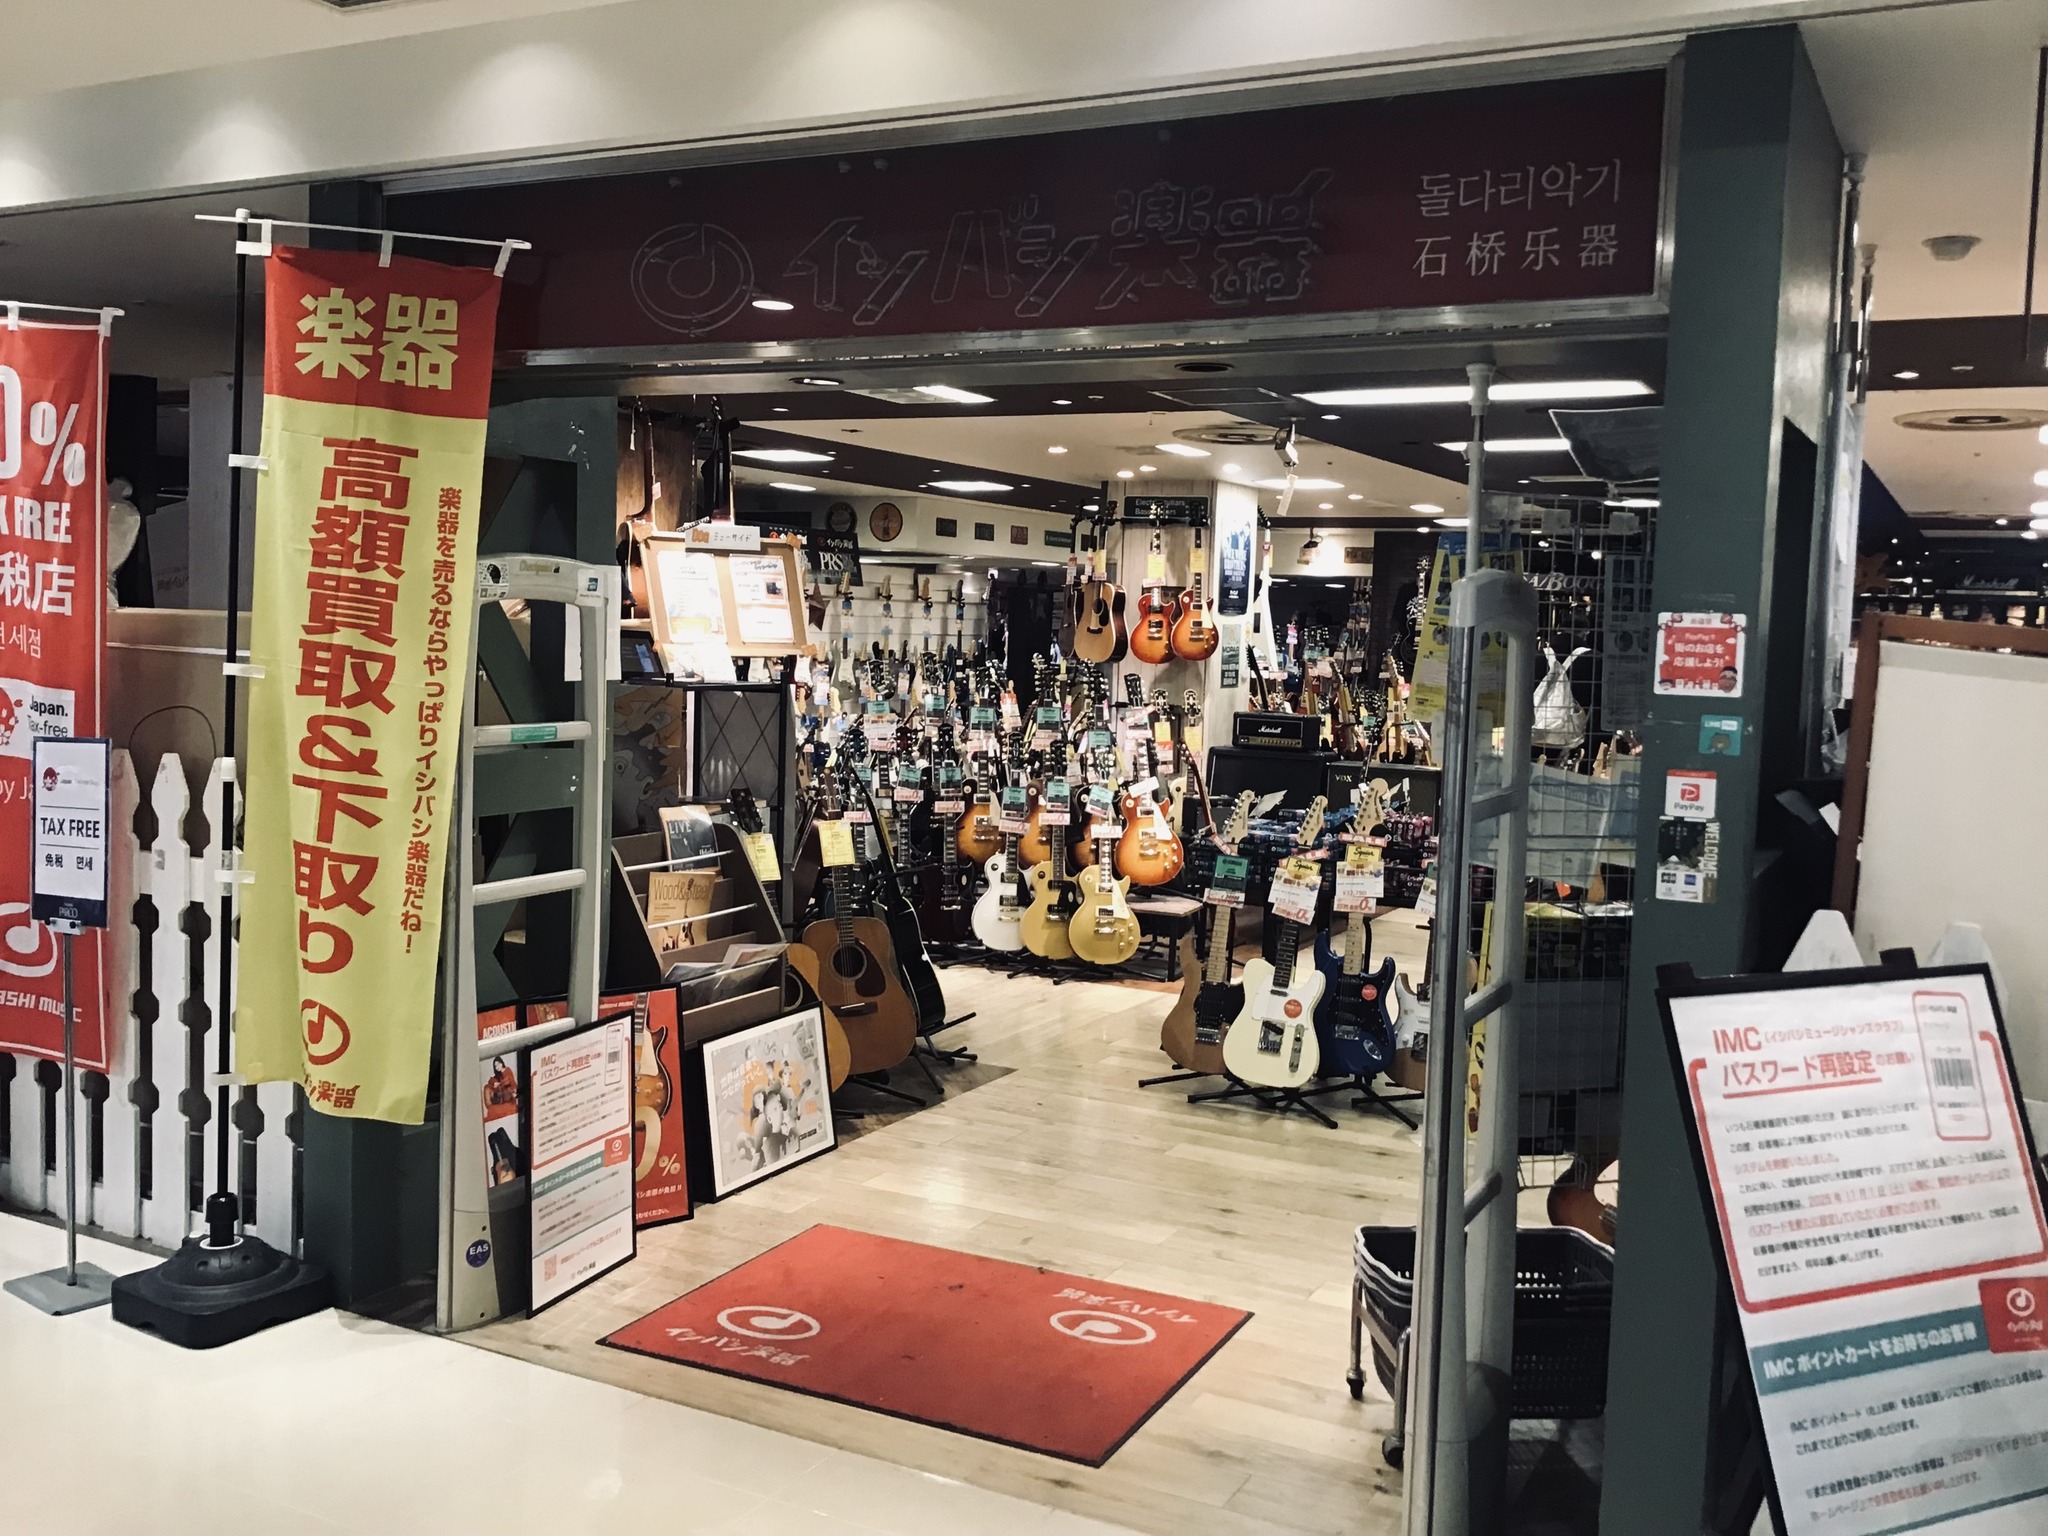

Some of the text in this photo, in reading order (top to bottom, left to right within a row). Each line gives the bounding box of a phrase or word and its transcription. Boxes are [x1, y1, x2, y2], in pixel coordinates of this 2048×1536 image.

[1416, 158, 1621, 217] 돌다리악기
[1412, 224, 1619, 278] 石桥乐器
[294, 287, 459, 390] 楽器
[14, 495, 73, 544] FREE
[819, 551, 844, 571] PRS
[29, 694, 69, 718] Japan.
[292, 436, 419, 974] 高額買取&下取り
[1335, 774, 1352, 782] VOX
[1673, 801, 1705, 812] PayPay
[40, 816, 101, 839] TAX FREE
[668, 821, 692, 834] LIVE
[45, 853, 64, 869] 免税
[1703, 821, 1720, 879] WELCOME
[1712, 1026, 1762, 1055] IMC
[469, 1243, 489, 1256] EAS
[1763, 1356, 1796, 1380] IMC
